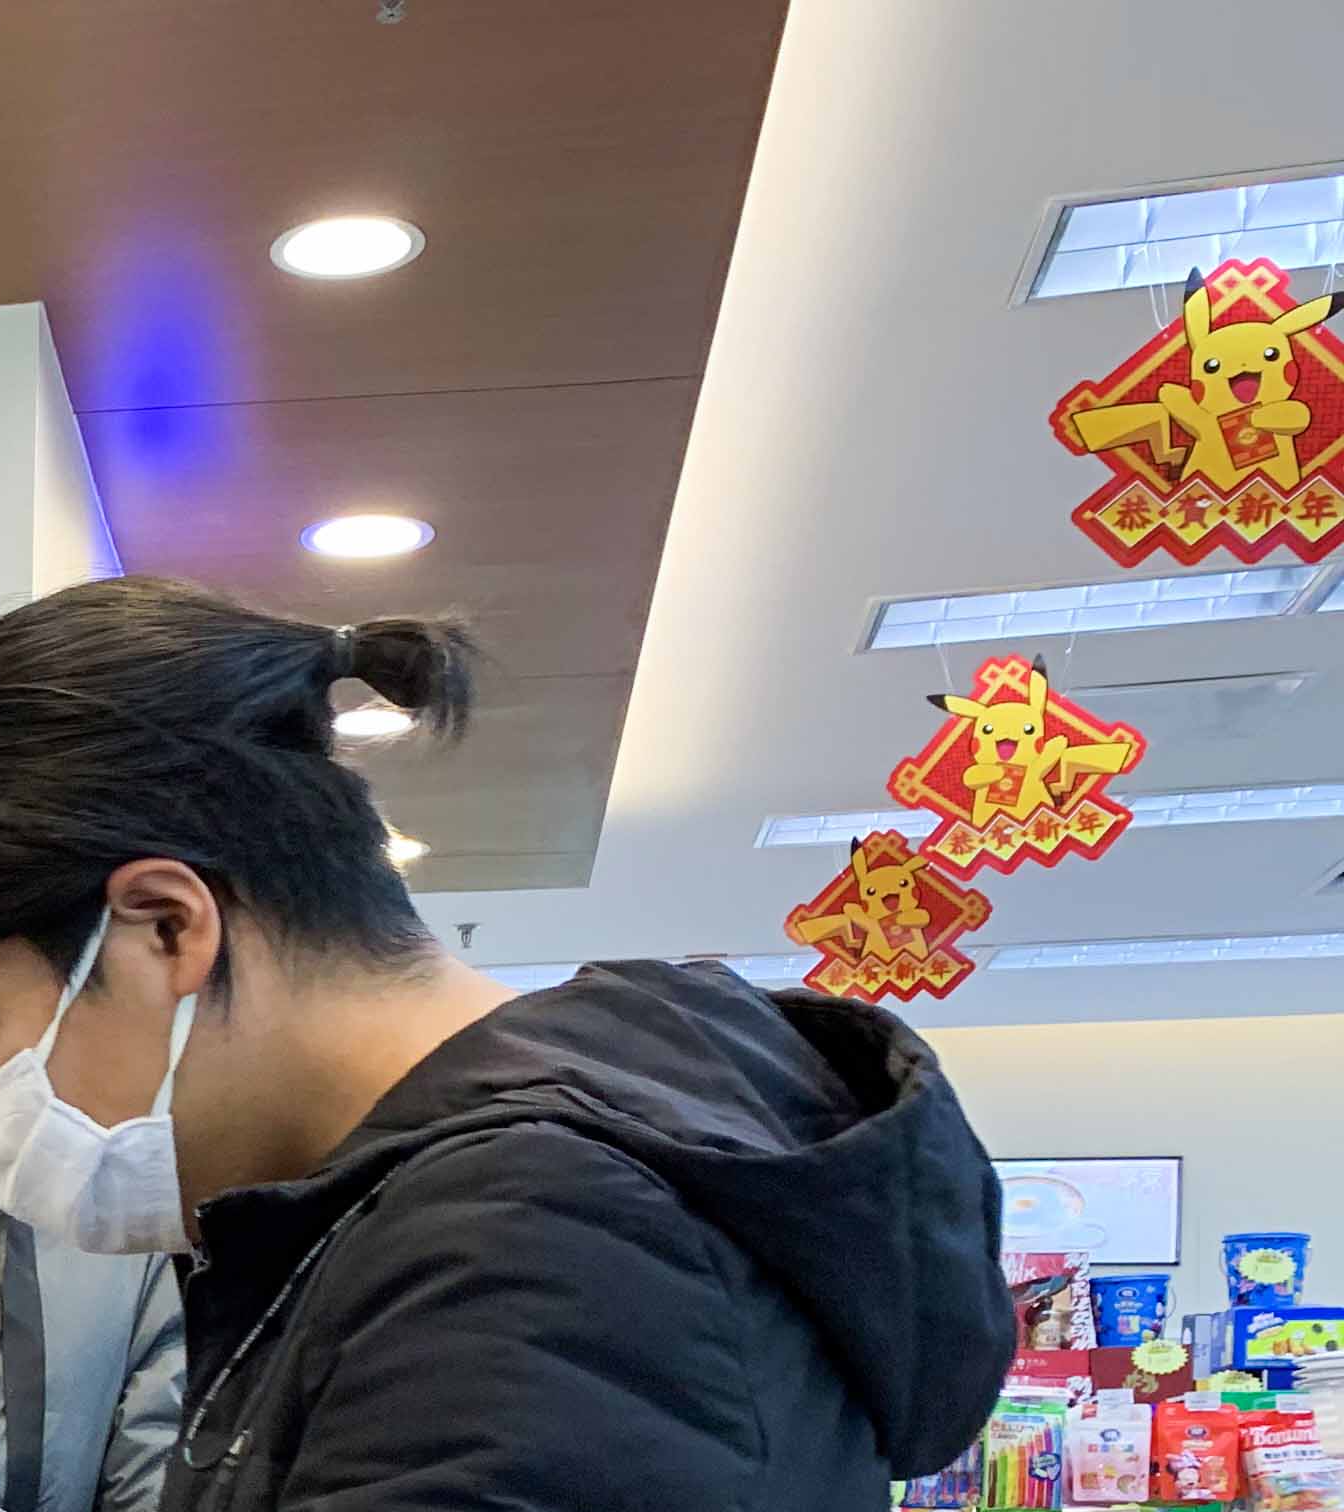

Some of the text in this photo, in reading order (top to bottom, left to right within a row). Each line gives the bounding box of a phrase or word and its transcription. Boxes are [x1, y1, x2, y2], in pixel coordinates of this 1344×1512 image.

[1113, 491, 1338, 531] 恭賀新年
[949, 810, 1105, 856] 恭賀新年
